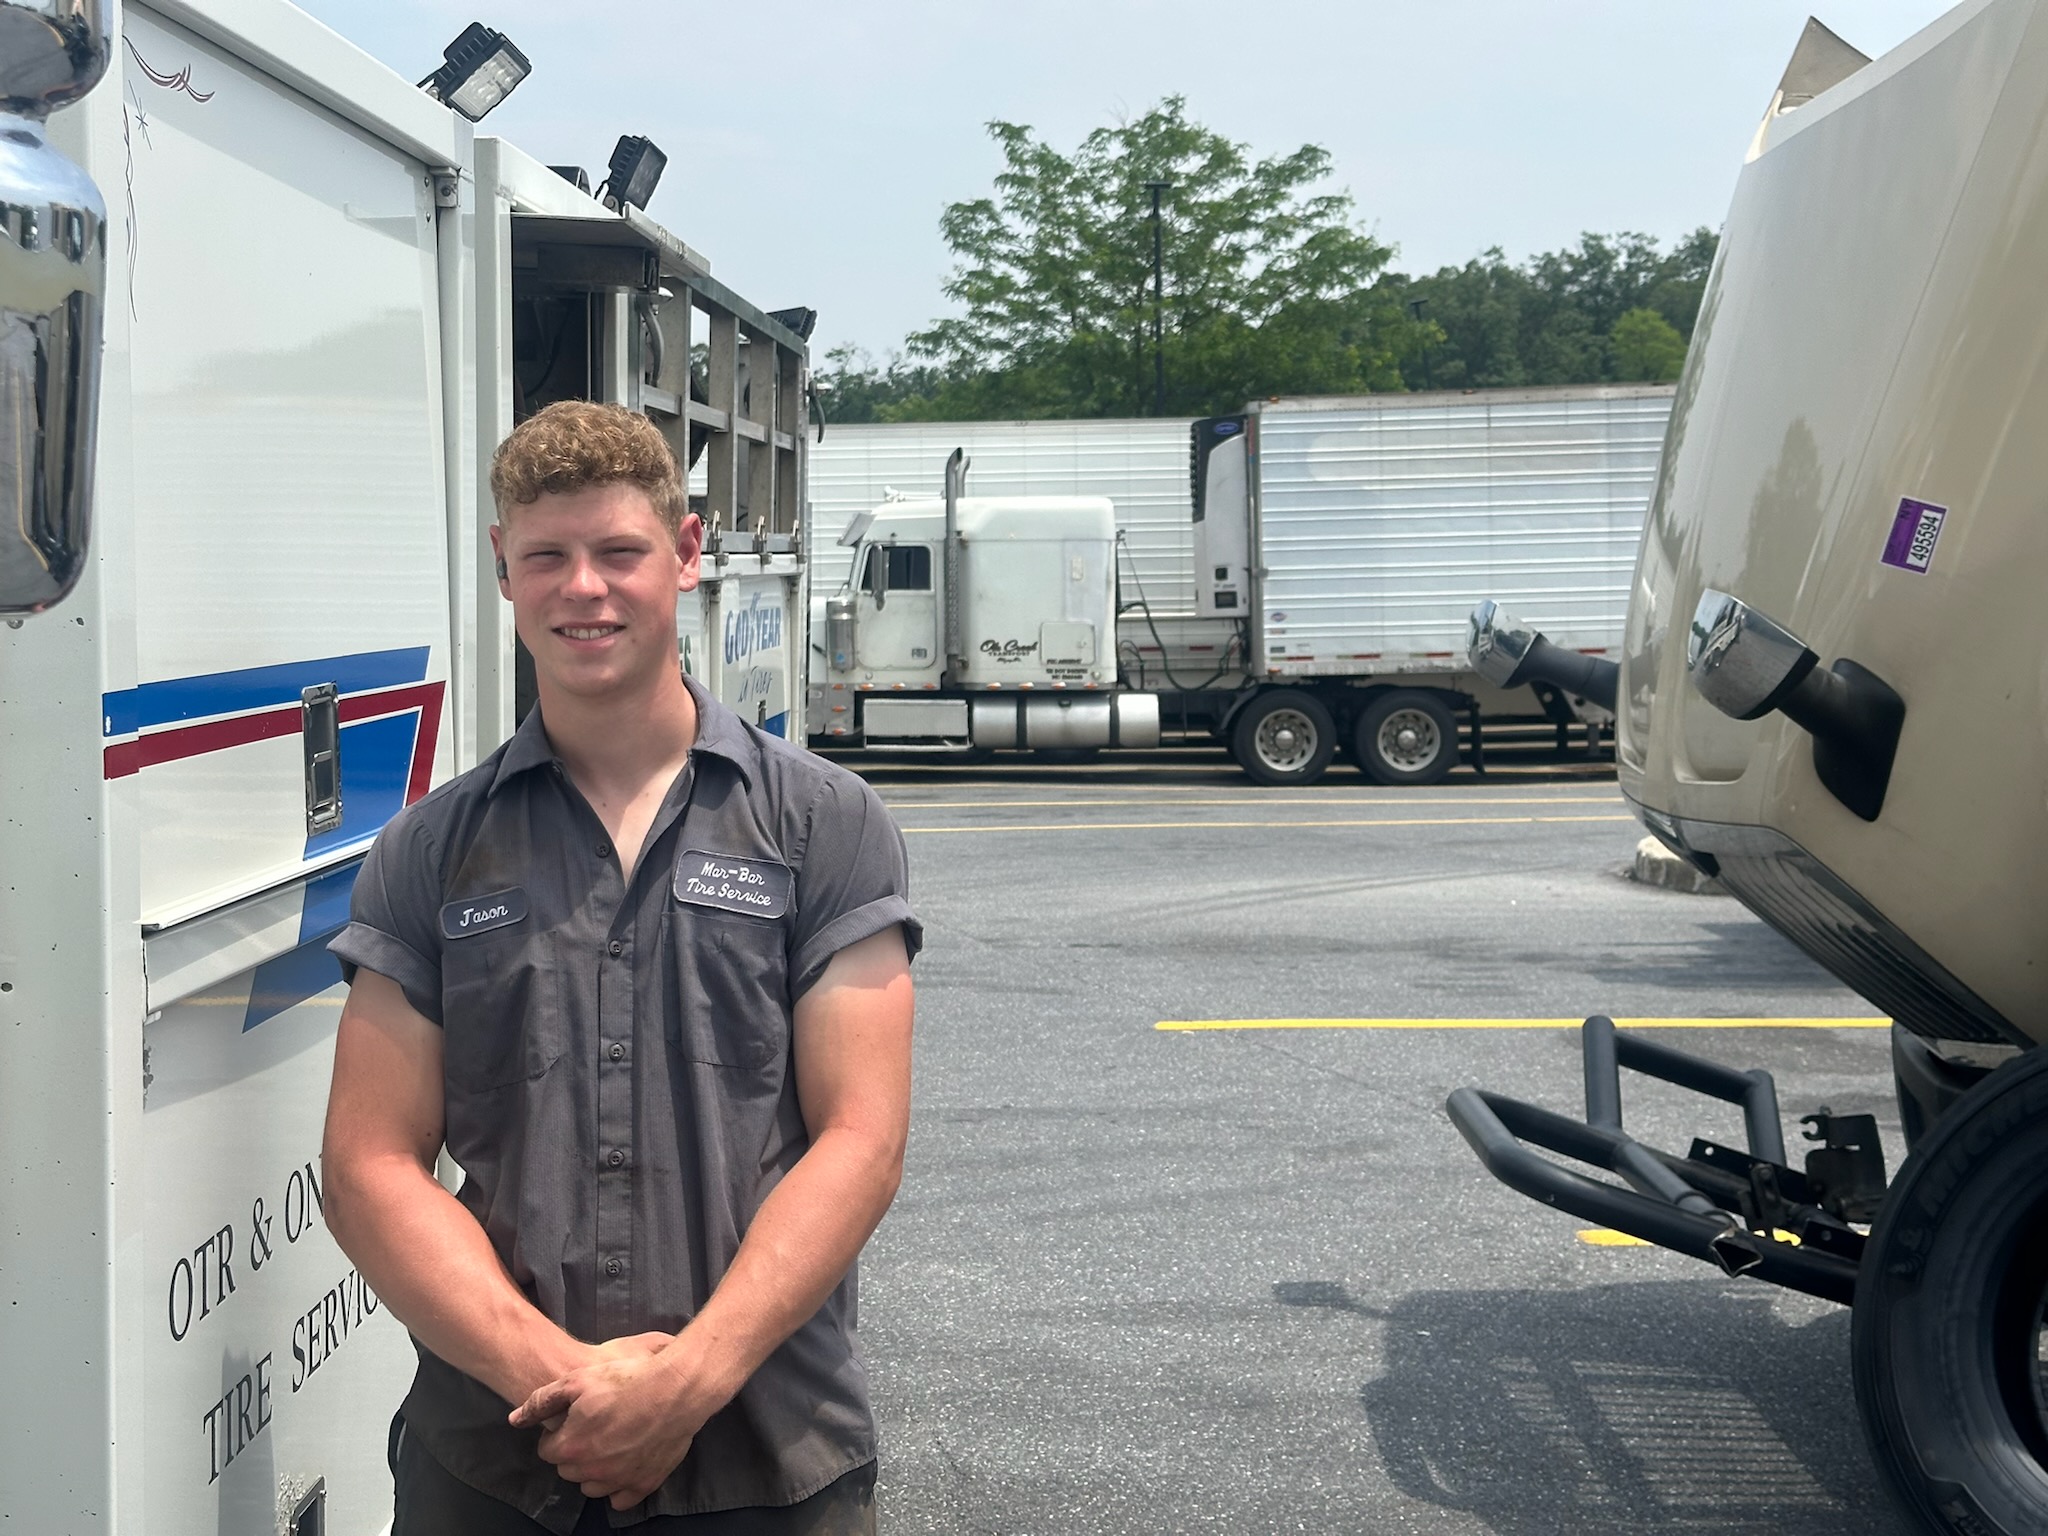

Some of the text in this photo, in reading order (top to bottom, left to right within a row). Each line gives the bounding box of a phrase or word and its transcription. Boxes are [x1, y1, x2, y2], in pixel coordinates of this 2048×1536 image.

[1910, 515, 1939, 561] 495594
[687, 877, 772, 907] Tire Service
[701, 861, 765, 886] Mar-Bar
[459, 904, 509, 928] Jason
[168, 1224, 236, 1341] OTR
[250, 1197, 273, 1271] &
[203, 1269, 383, 1485] TIRE SERVIC
